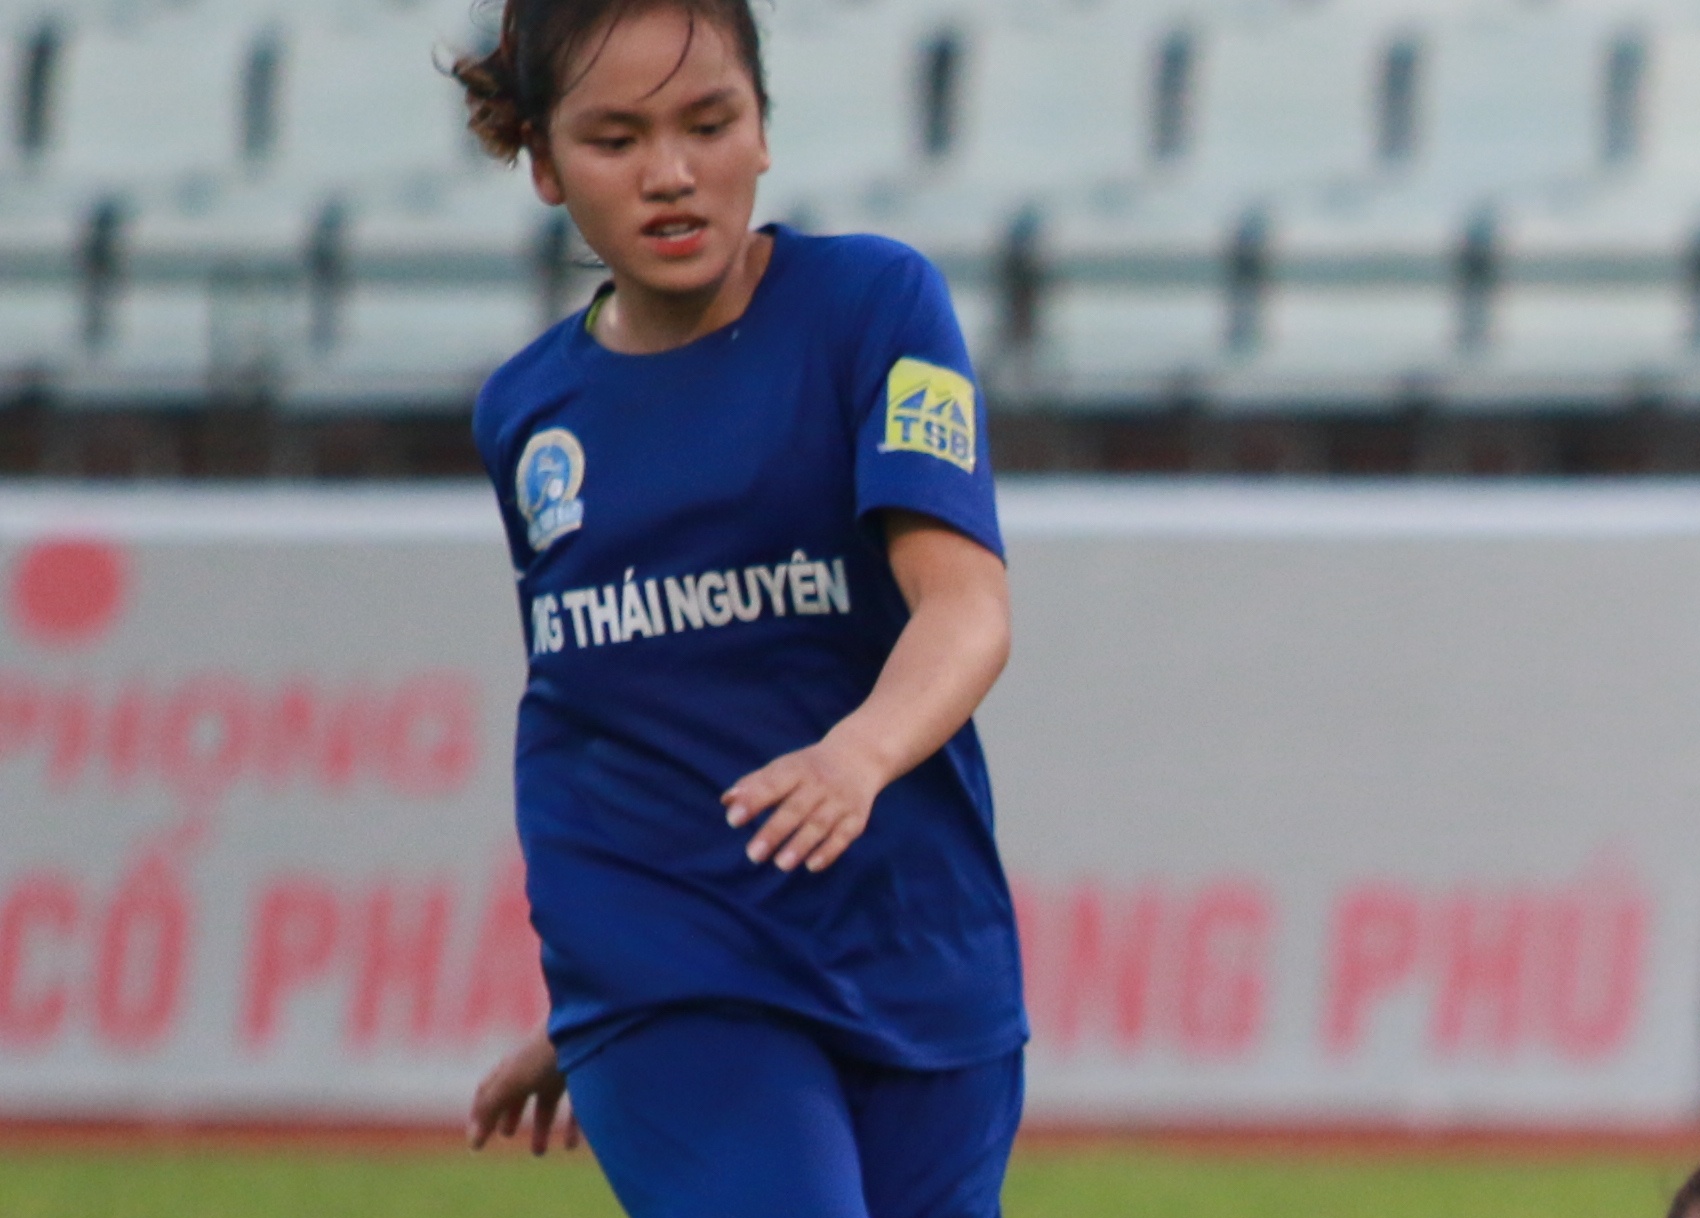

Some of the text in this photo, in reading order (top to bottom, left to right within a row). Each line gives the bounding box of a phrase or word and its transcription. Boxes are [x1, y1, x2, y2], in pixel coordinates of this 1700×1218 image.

[893, 414, 969, 459] TSB
[562, 566, 666, 649] THÁI
[664, 548, 851, 634] NGUYÊN
